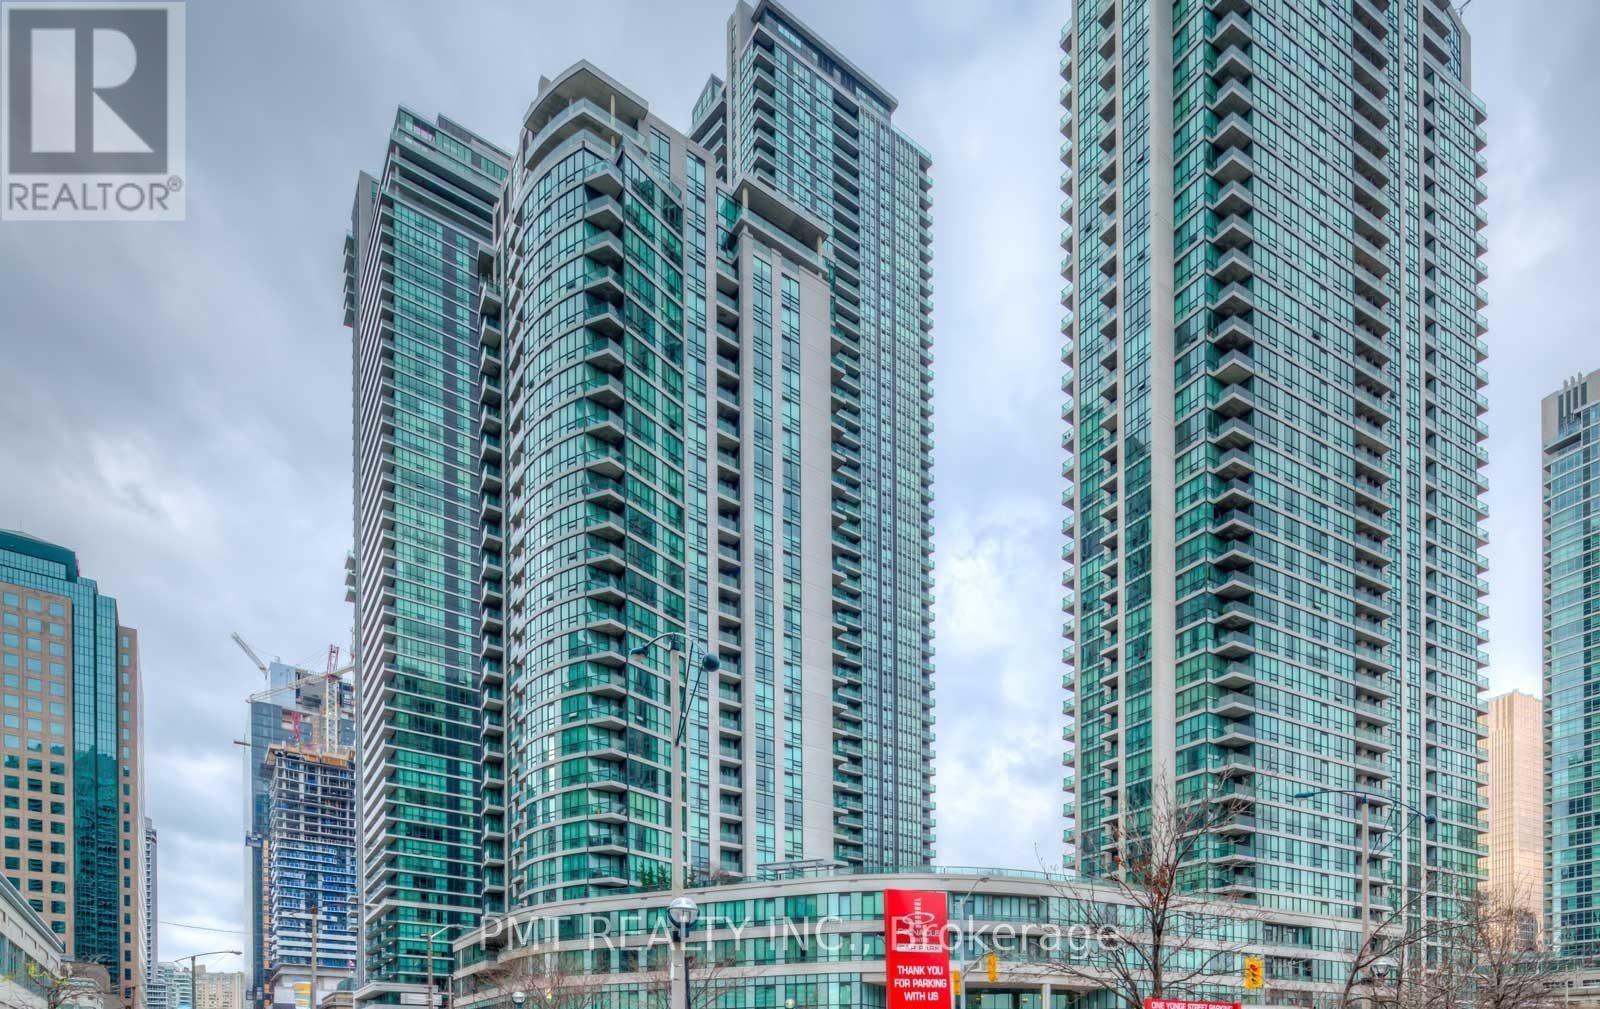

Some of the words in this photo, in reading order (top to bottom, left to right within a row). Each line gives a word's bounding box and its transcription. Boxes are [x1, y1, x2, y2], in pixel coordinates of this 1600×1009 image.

[897, 965, 925, 975] THANK
[927, 965, 943, 975] YOU
[894, 978, 911, 988] FOR
[912, 978, 947, 988] PARKING
[904, 991, 926, 1001] WITH
[928, 991, 939, 1001] US
